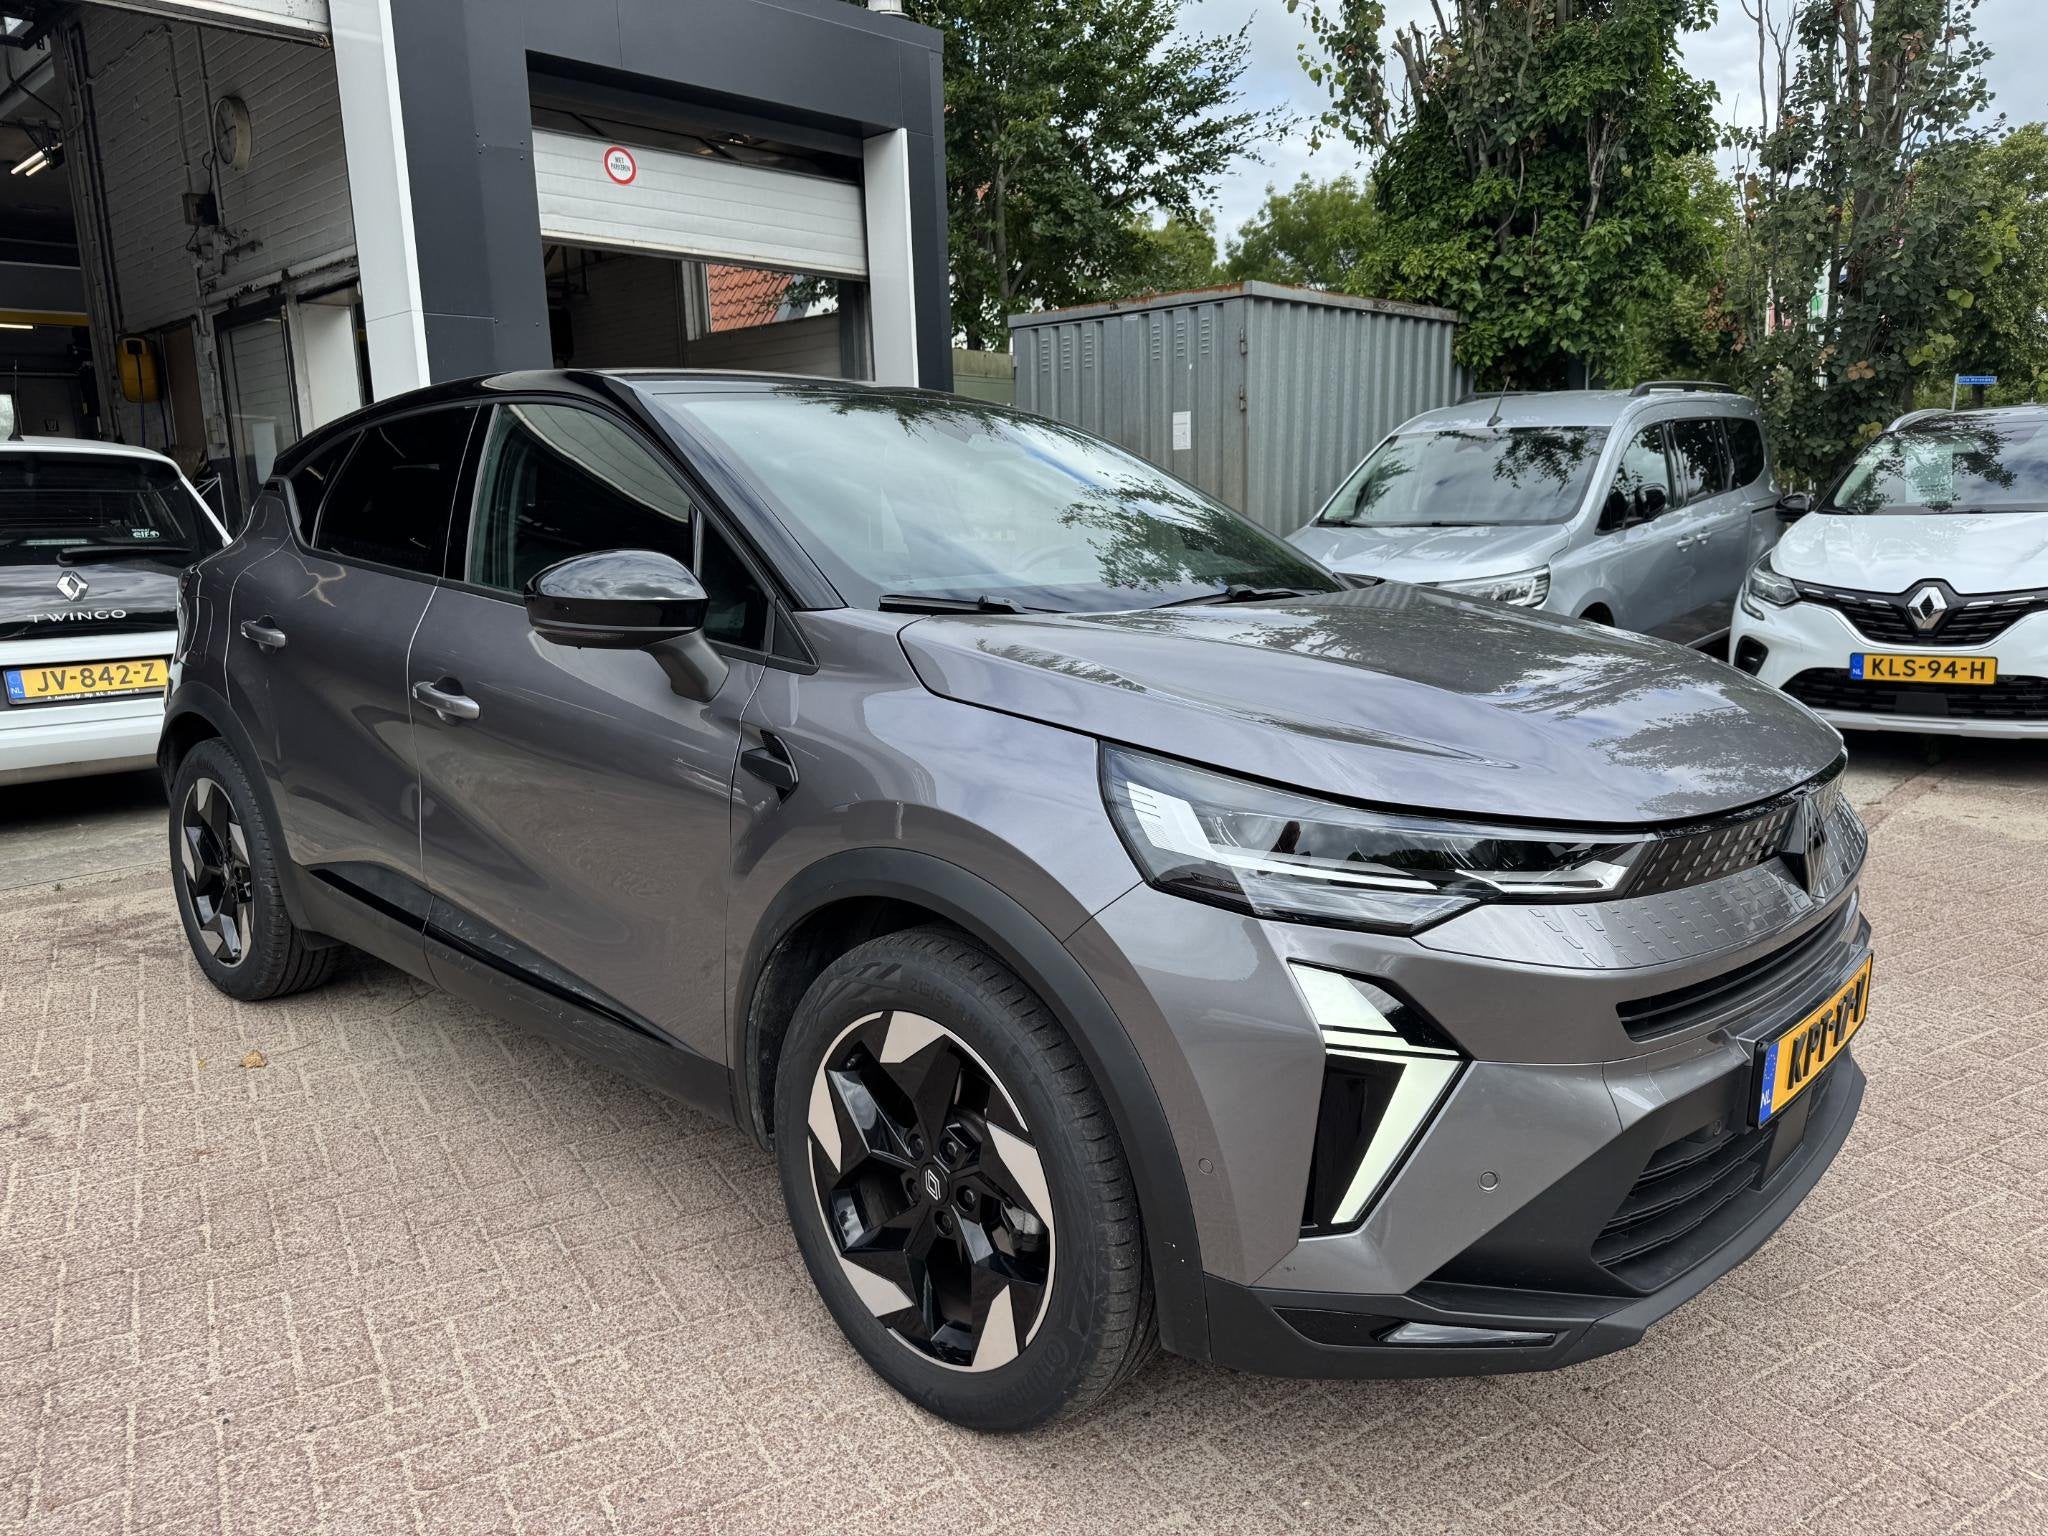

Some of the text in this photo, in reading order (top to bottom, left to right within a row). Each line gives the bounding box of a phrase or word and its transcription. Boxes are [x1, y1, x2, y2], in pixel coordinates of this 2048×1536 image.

[27, 609, 127, 624] TWINGO
[37, 662, 158, 692] JV-842-Z
[1852, 668, 1862, 676] NL
[1871, 658, 1986, 680] KLS-94-H
[11, 687, 23, 695] NL
[1760, 1089, 1771, 1109] NL
